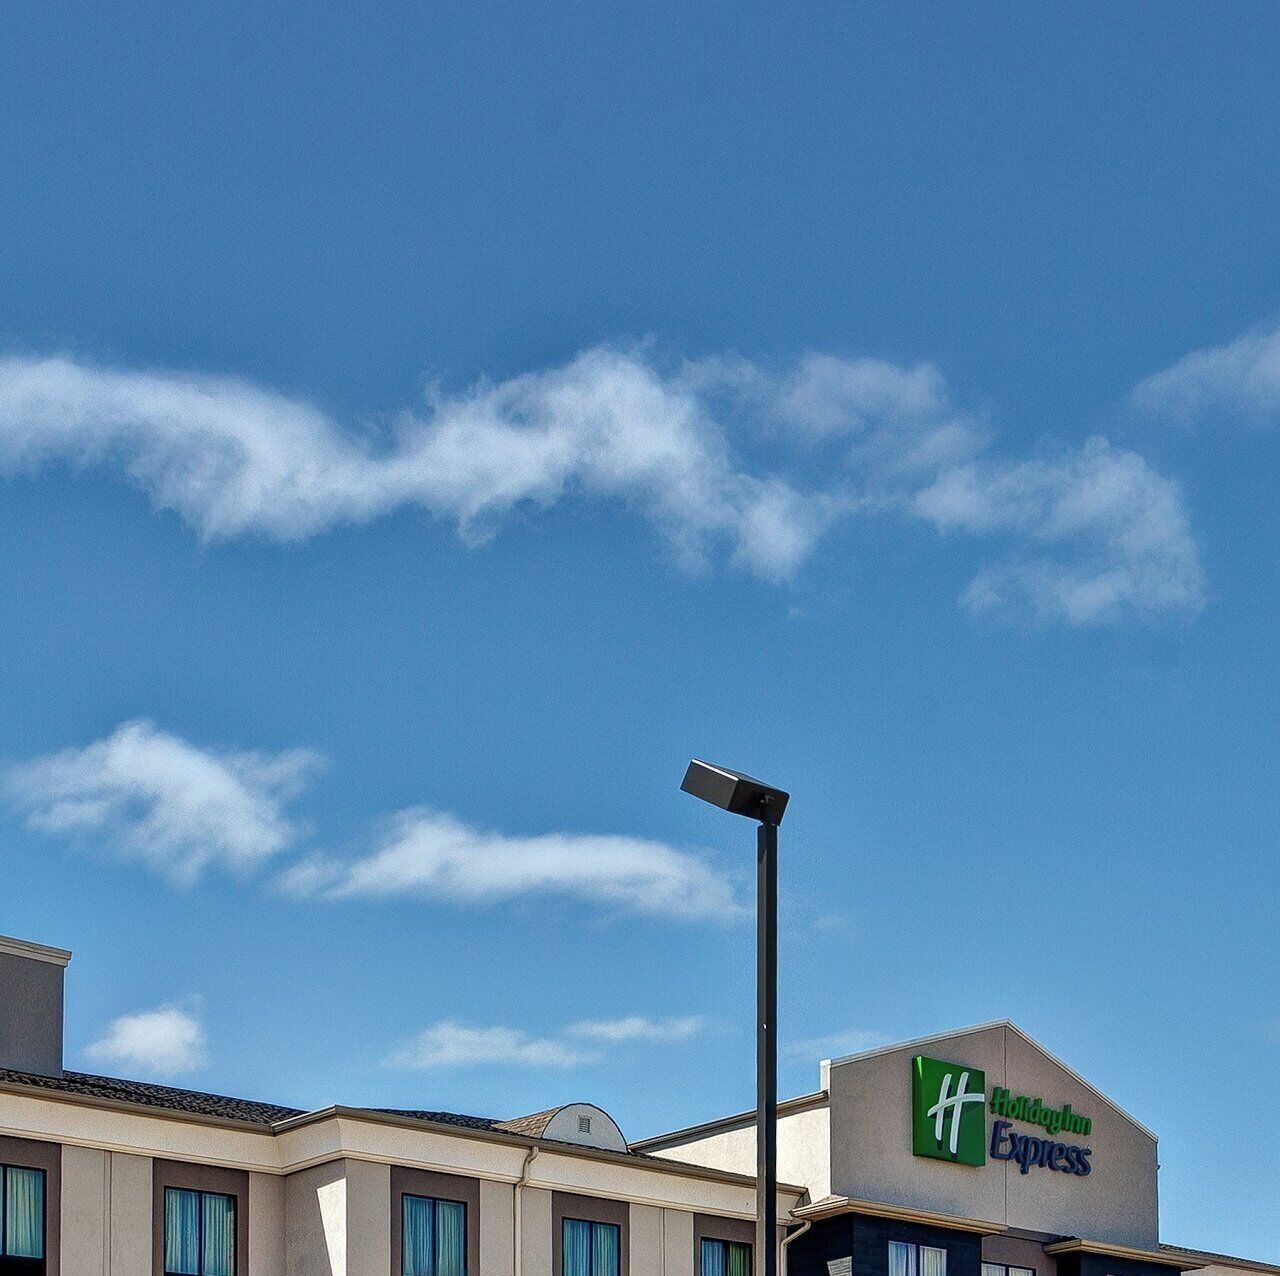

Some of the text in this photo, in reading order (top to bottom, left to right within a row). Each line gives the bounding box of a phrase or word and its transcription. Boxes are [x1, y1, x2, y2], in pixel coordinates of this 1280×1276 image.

[989, 1087, 1092, 1136] Holiday Inn
[989, 1120, 1092, 1176] Express
